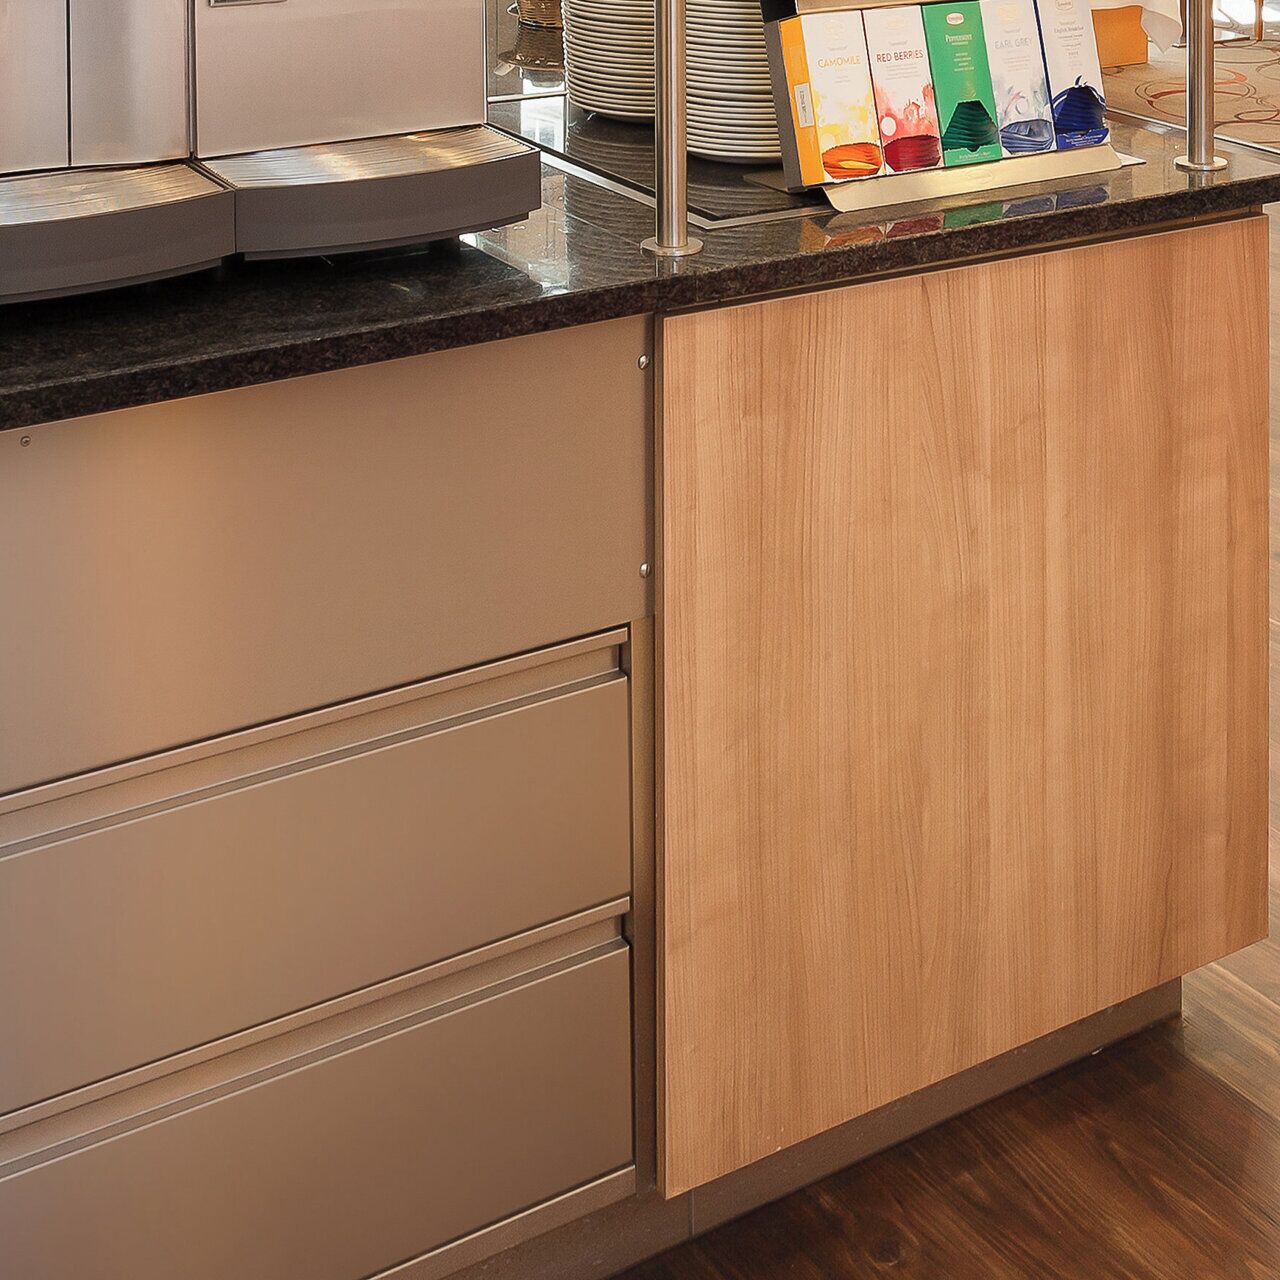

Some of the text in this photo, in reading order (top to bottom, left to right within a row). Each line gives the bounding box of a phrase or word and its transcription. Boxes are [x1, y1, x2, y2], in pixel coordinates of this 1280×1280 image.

[994, 37, 1033, 49] EARL GREY
[817, 55, 862, 68] CAMOMILE
[876, 50, 924, 63] RED BERRIES
